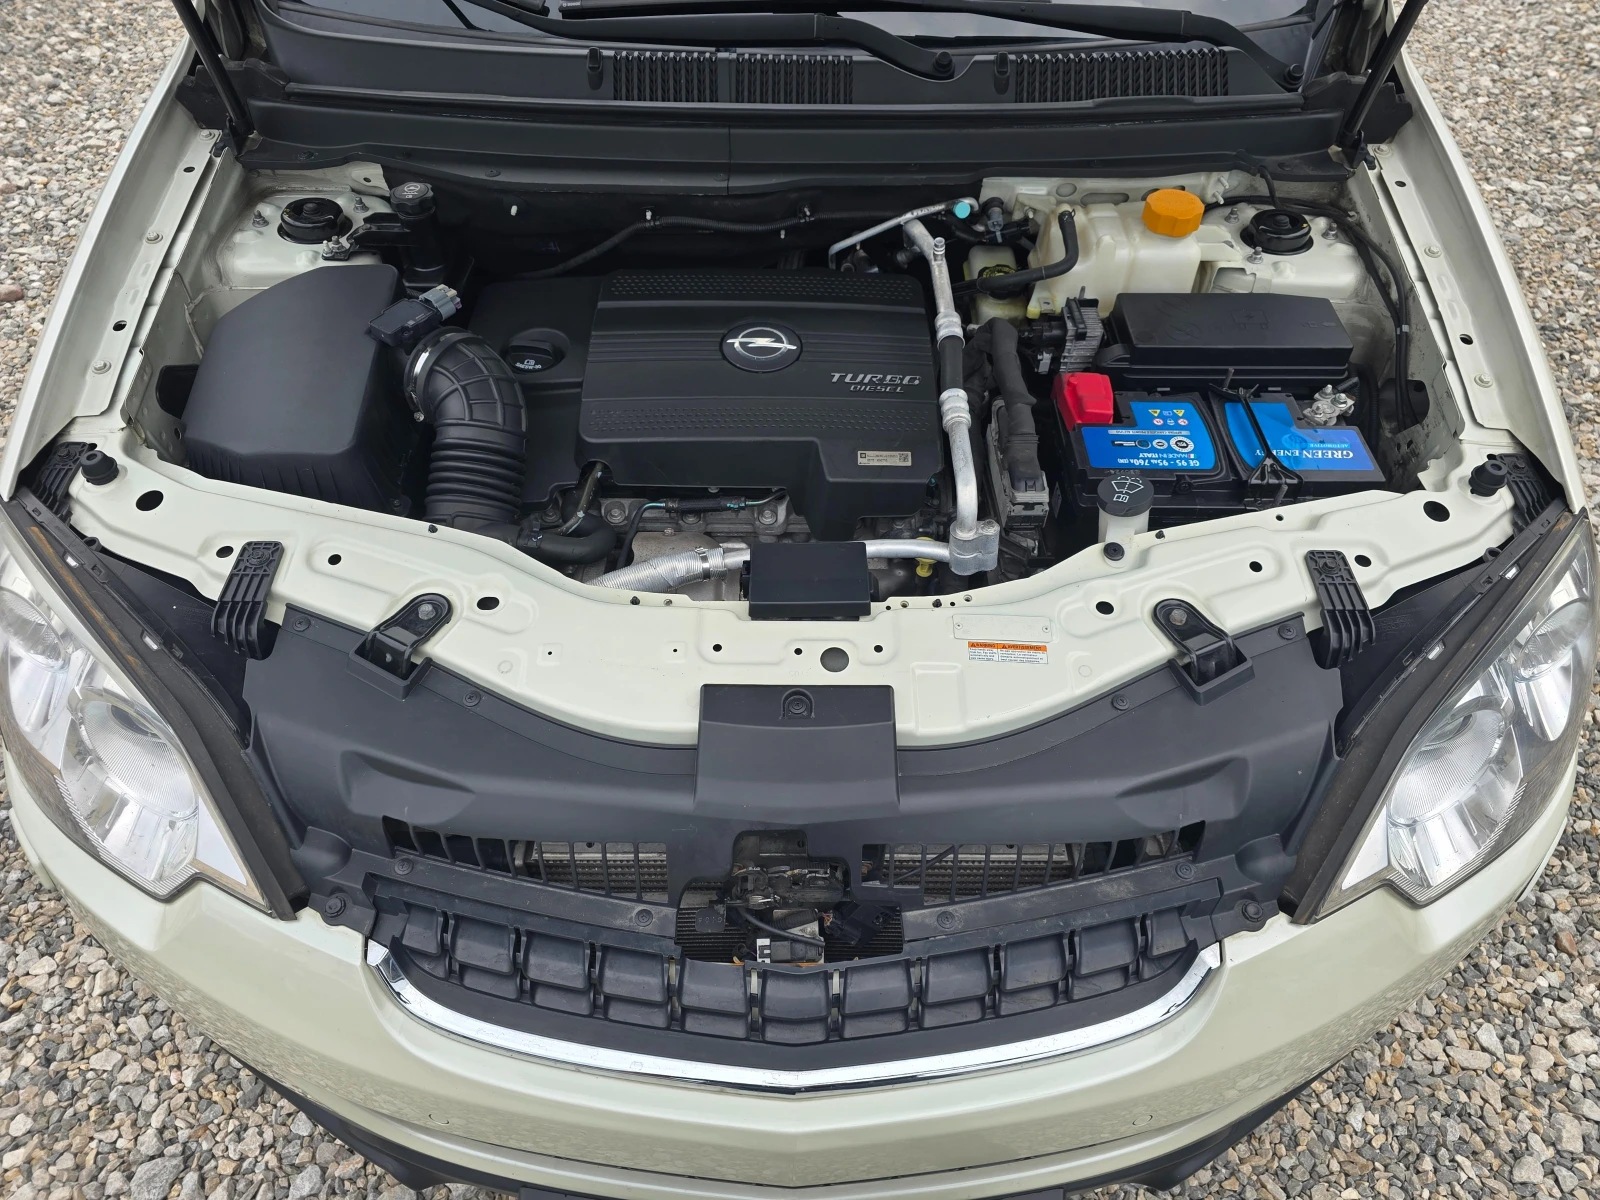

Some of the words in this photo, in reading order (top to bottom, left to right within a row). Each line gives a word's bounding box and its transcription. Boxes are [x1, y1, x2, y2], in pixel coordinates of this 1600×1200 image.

[830, 372, 921, 385] TURBO
[850, 385, 904, 393] DIESEL
[1254, 449, 1300, 457] ENEY
[1302, 450, 1354, 459] GREEN
